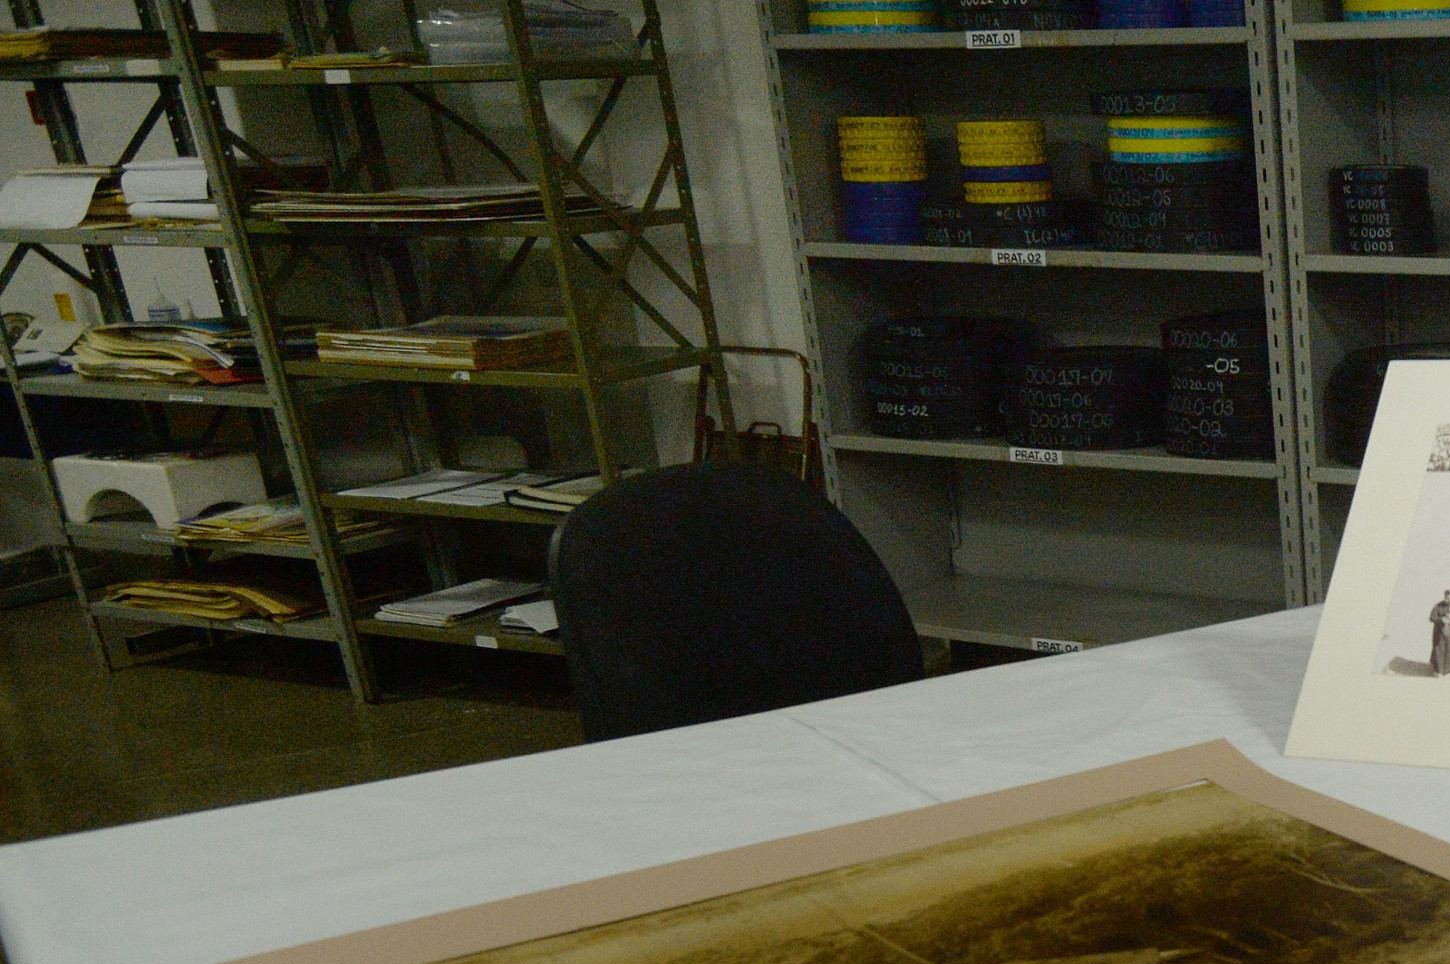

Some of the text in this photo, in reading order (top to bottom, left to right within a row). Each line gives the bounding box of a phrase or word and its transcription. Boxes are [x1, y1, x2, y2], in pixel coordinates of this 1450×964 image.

[972, 33, 1015, 46] PRAT. 01
[997, 252, 1042, 264] PRAT. 02
[1015, 449, 1058, 463] PRAT. 03
